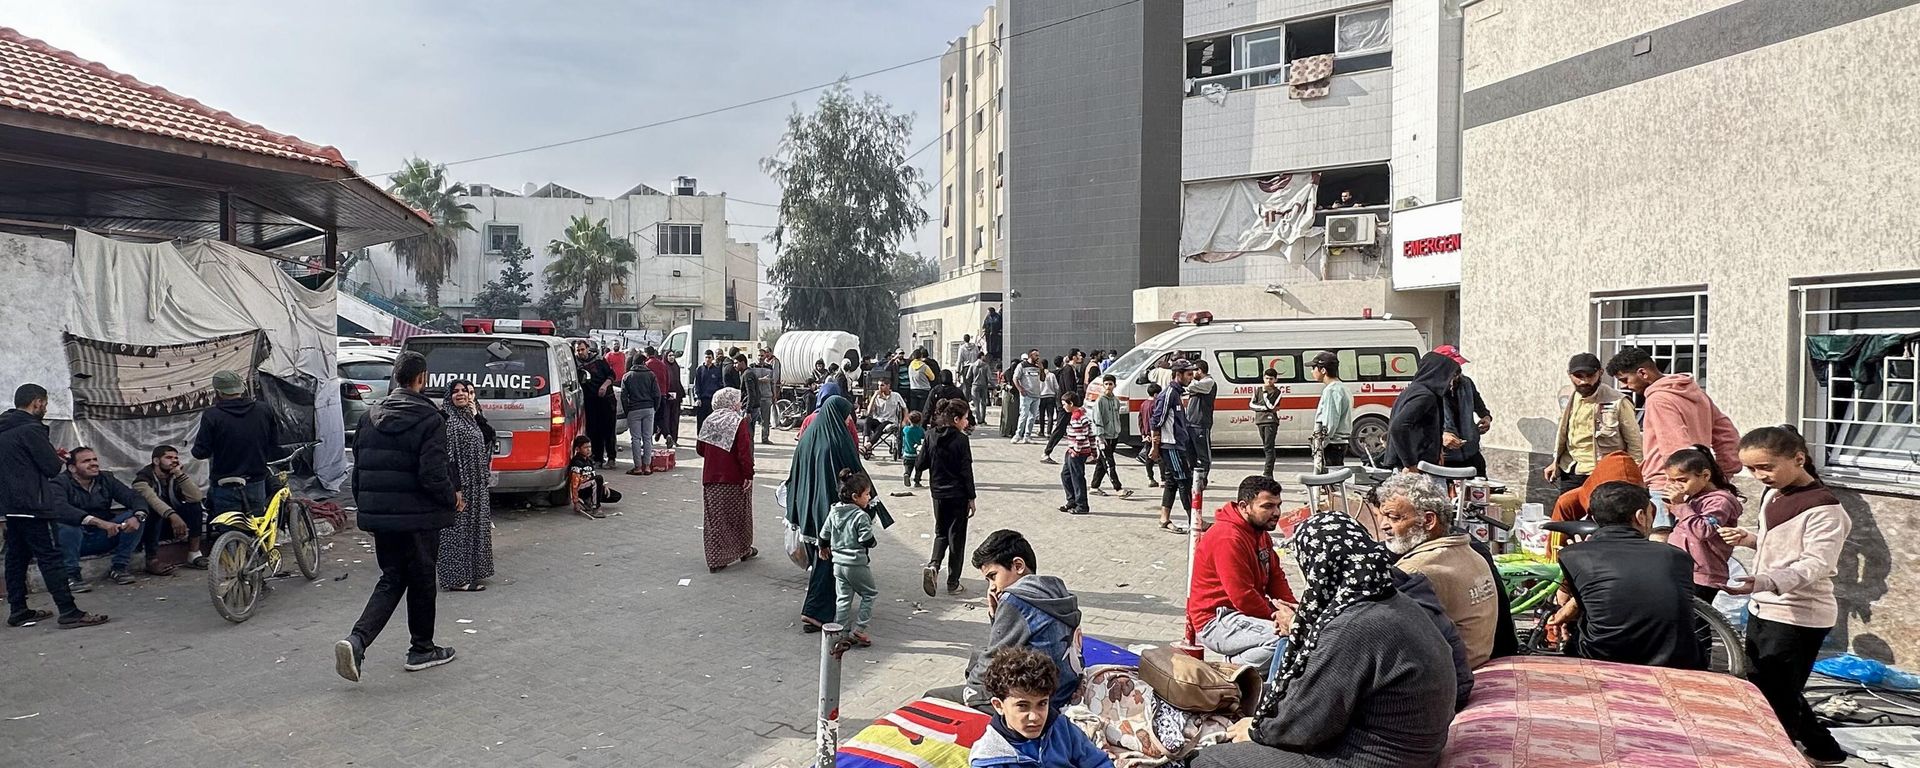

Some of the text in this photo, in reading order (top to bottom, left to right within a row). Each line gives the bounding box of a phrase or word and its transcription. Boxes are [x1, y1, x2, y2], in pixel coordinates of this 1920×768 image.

[1403, 233, 1461, 258] EMERGEN
[425, 373, 531, 389] MBLANCE
[1233, 385, 1291, 395] AMBCE
[1361, 383, 1410, 393] سعاف
